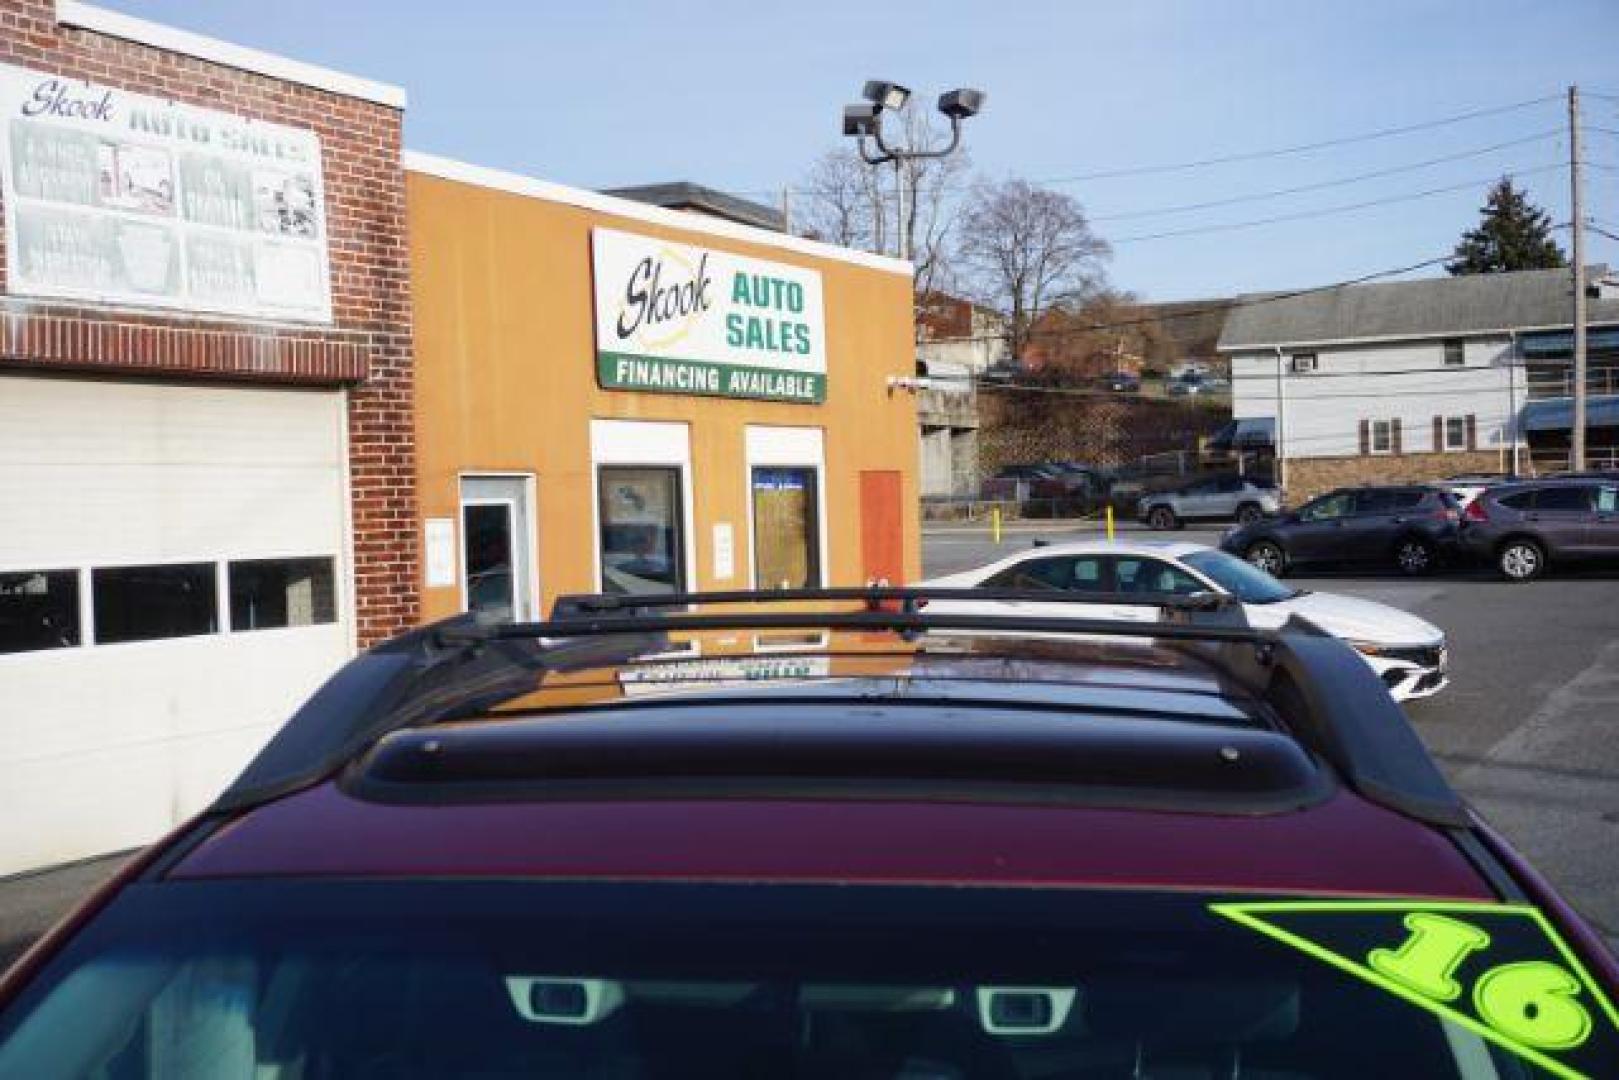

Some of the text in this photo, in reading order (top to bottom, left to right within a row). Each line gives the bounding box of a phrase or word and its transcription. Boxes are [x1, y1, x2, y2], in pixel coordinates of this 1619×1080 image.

[21, 80, 112, 122] Skook
[616, 252, 711, 339] Skook
[732, 272, 803, 313] AUTO
[726, 313, 810, 355] SALES
[616, 358, 816, 398] FINANCING AVAILABLE
[1367, 912, 1592, 1050] 16
